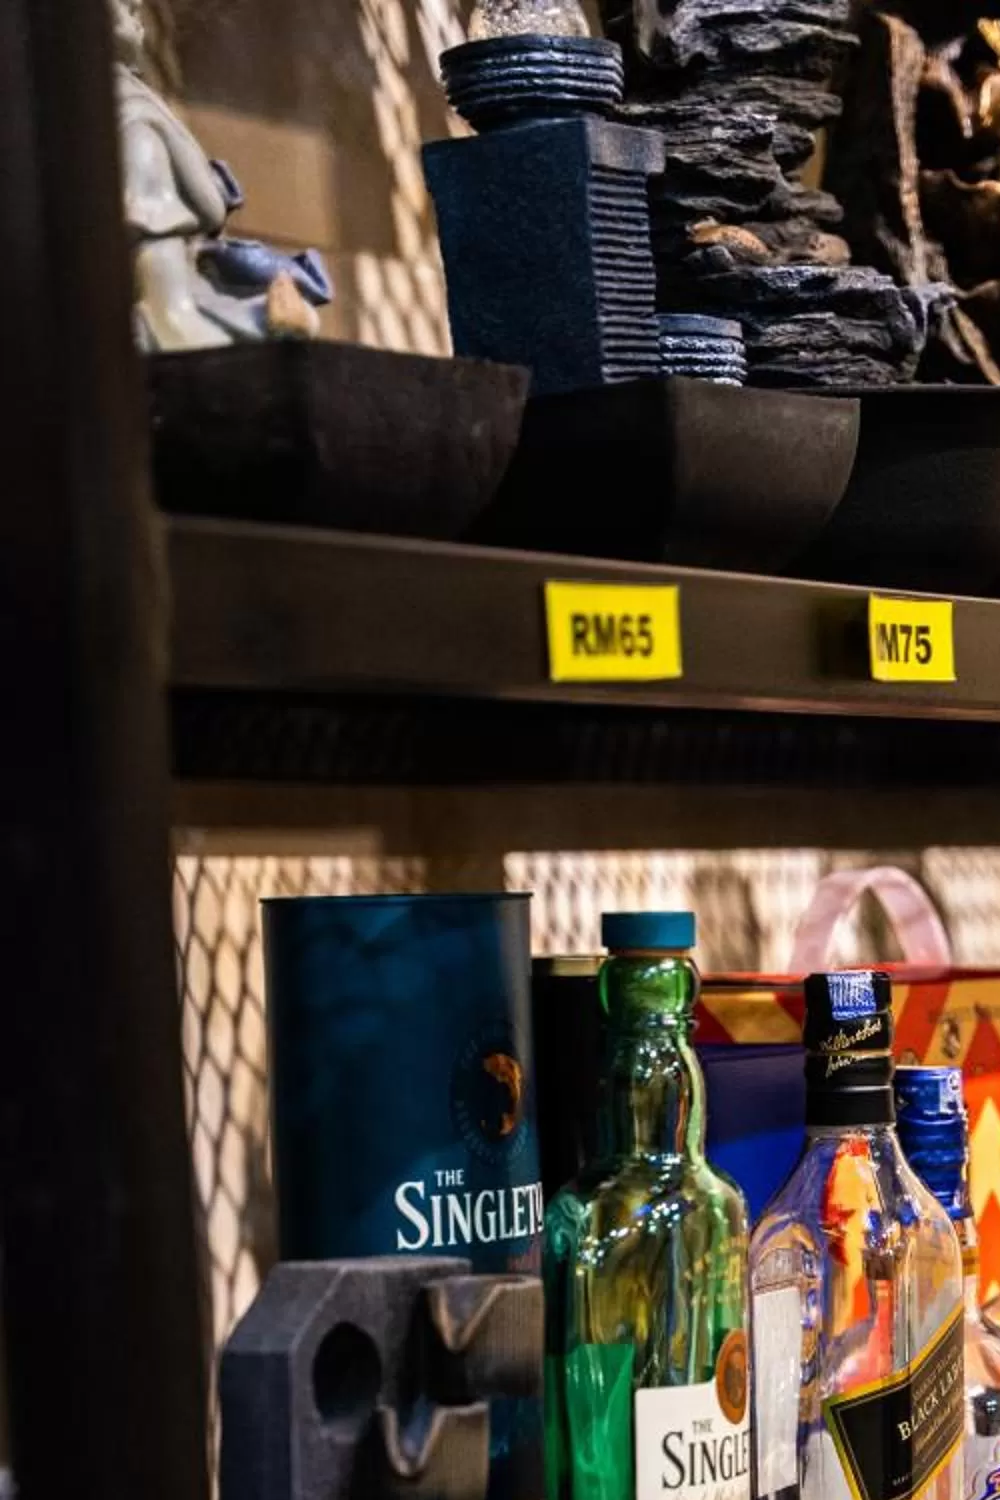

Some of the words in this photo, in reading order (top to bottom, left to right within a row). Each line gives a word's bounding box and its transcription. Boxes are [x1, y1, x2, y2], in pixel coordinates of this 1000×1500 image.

[570, 613, 654, 658] RM65
[434, 1169, 465, 1187] THE
[692, 1418, 714, 1434] THE
[897, 1385, 939, 1441] BLACK
